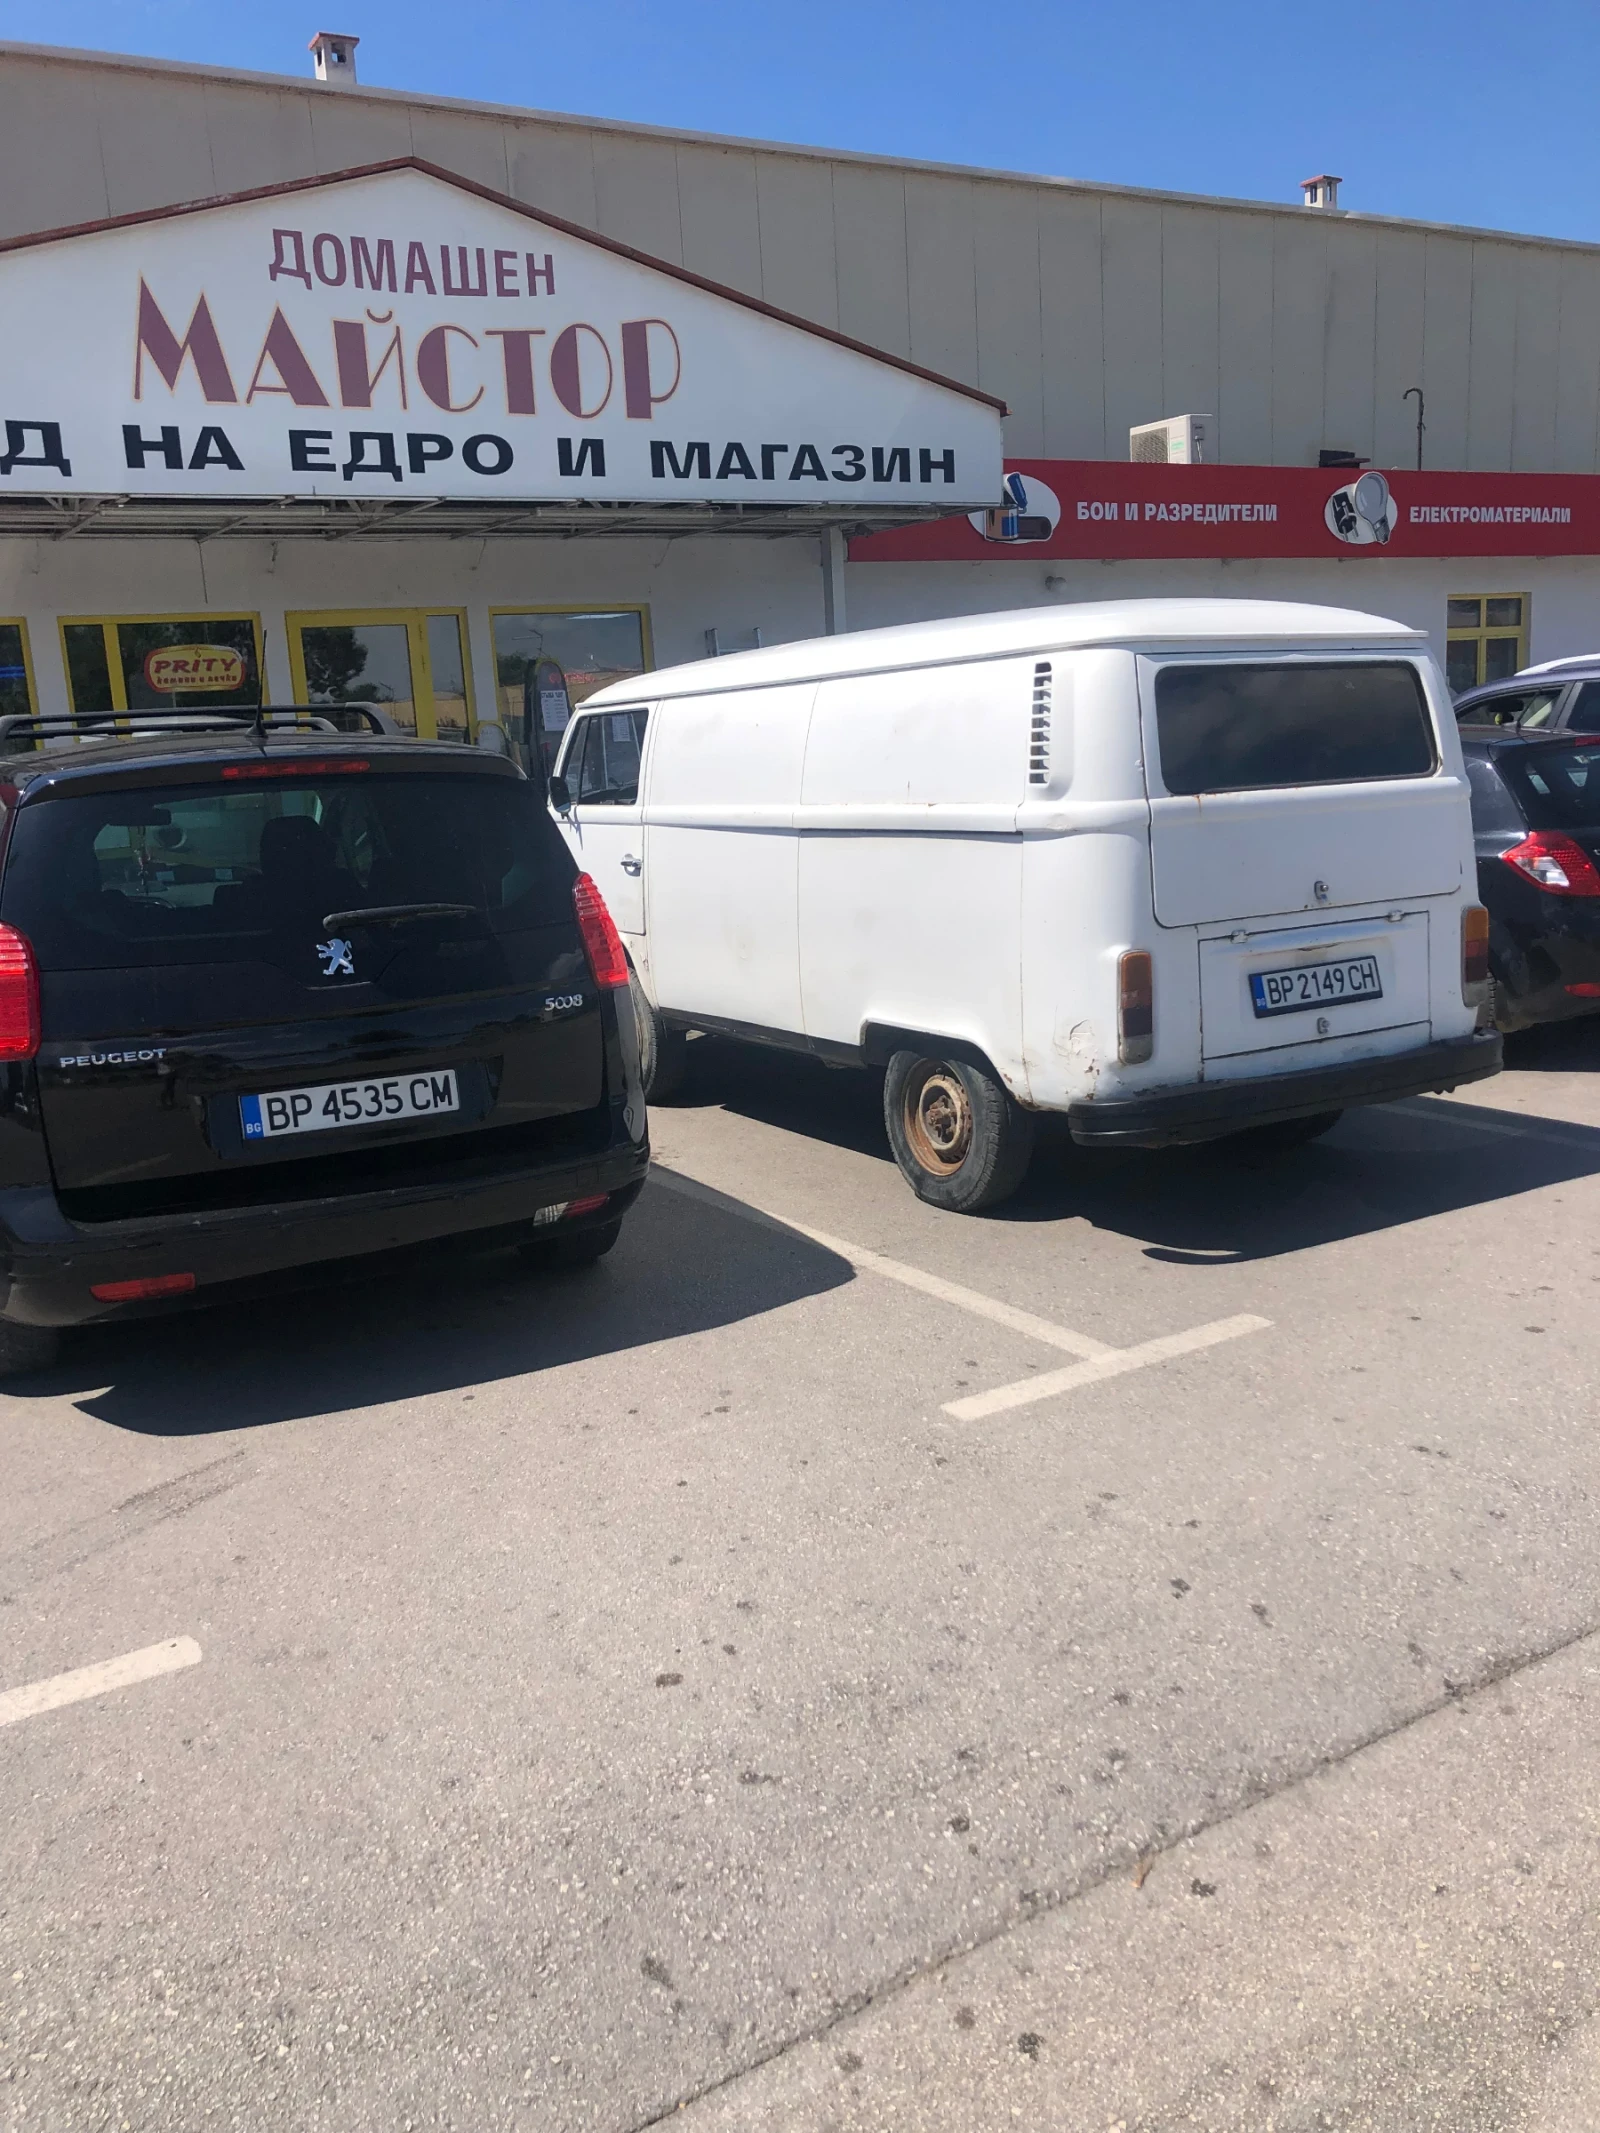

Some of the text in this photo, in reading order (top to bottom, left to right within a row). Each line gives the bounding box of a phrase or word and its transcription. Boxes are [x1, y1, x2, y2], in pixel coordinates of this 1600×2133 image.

[269, 229, 555, 297] ДОМАШЕН
[134, 272, 680, 420] МАЙСТОР
[122, 425, 245, 471] НА
[289, 430, 514, 482] ЕДРО
[557, 437, 606, 477] И
[650, 440, 956, 484] МАГАЗИН
[1076, 501, 1278, 525] БОИ И РАЗРЕДИТЕЛИ
[1409, 506, 1571, 523] ЕЛЕКТРОМАТЕРИАЛИ
[154, 658, 238, 674] PRITY
[1297, 967, 1345, 1000] 2149
[544, 993, 583, 1011] 5008
[60, 1048, 167, 1068] PEUGEOT
[322, 1081, 403, 1122] 4535
[246, 1123, 262, 1134] BG
